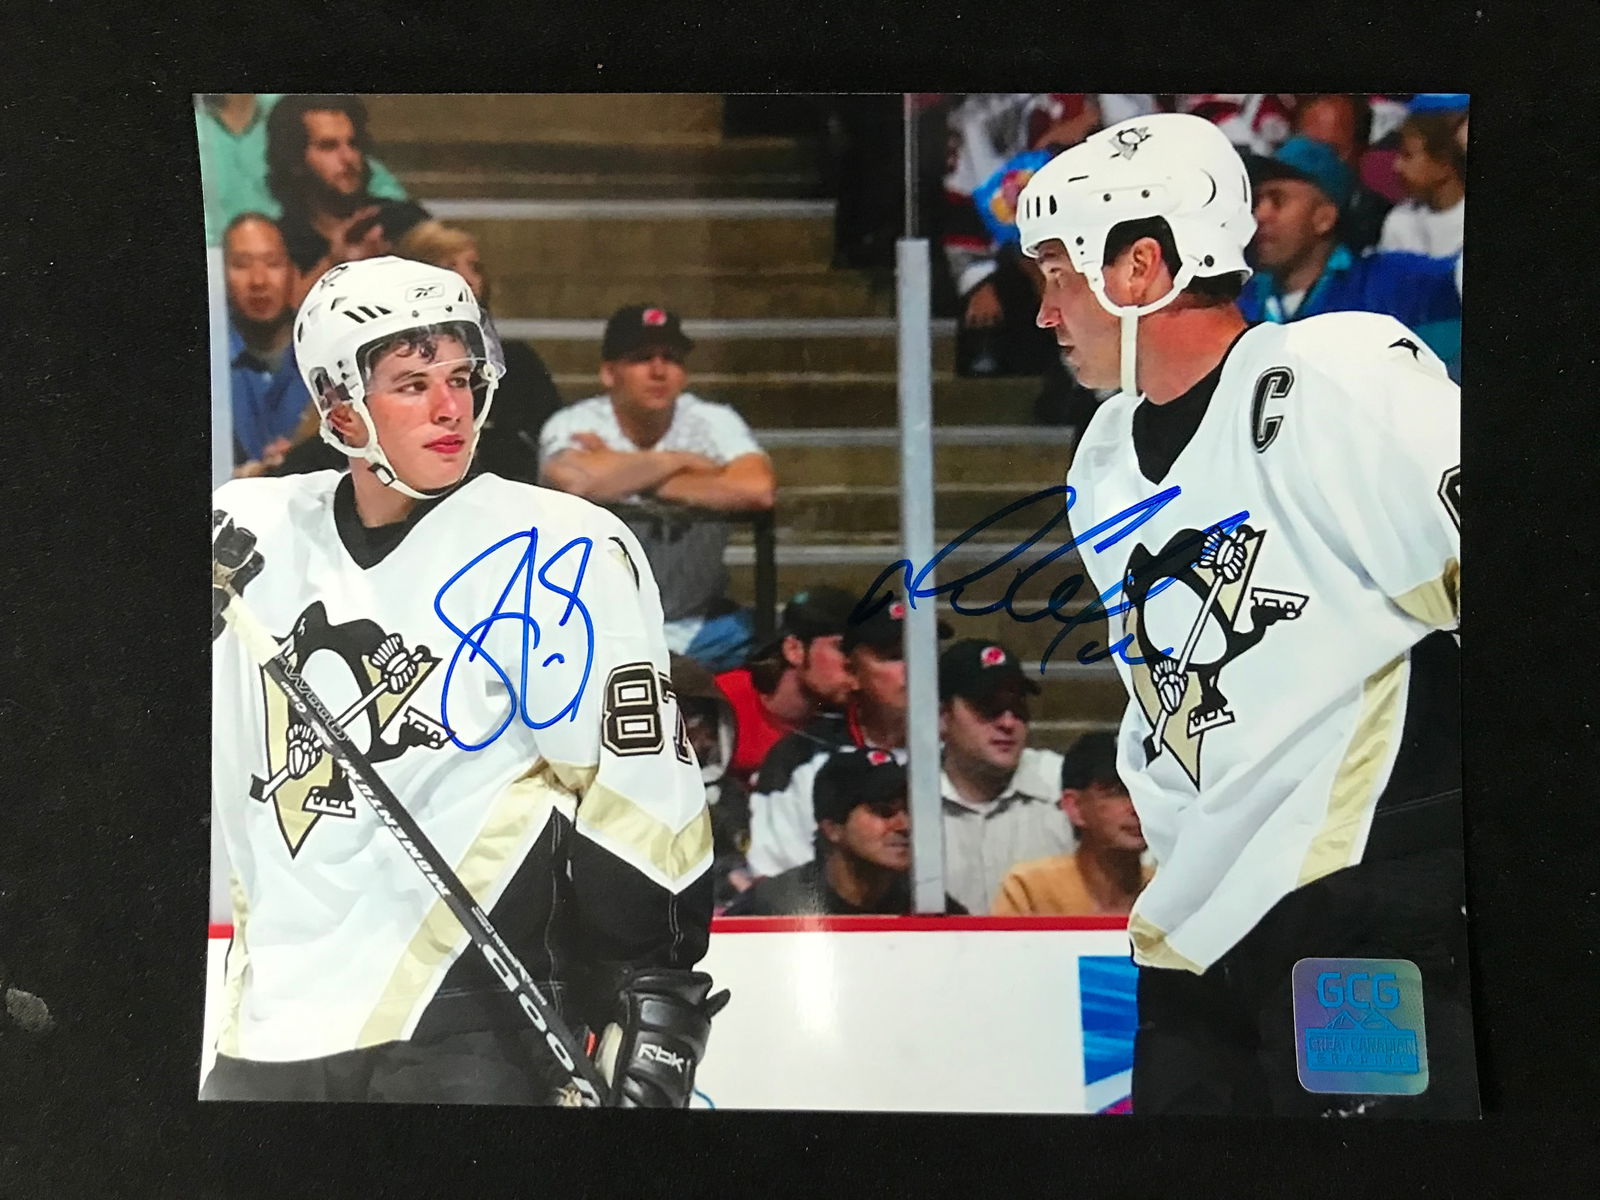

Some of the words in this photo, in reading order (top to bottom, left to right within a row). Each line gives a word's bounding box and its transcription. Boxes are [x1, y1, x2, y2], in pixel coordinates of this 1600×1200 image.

[1250, 366, 1294, 453] C
[338, 758, 451, 898] MOMENTUM
[1317, 972, 1400, 1009] GCG
[638, 1043, 684, 1073] Rbk
